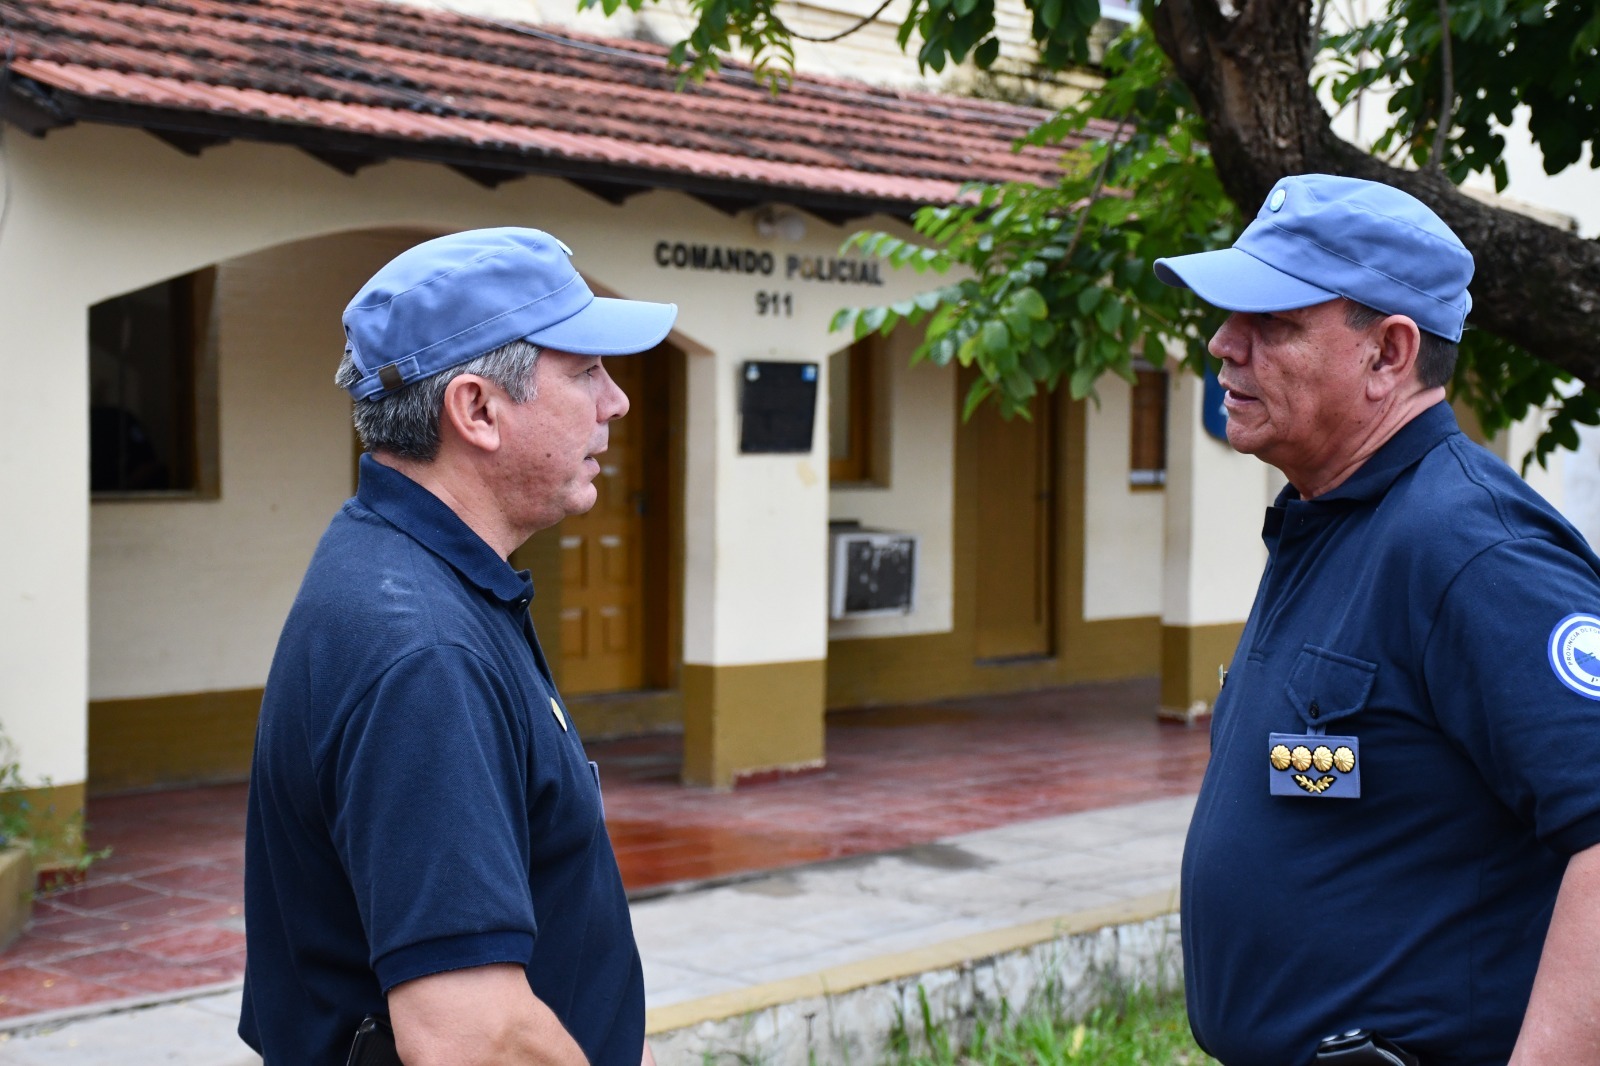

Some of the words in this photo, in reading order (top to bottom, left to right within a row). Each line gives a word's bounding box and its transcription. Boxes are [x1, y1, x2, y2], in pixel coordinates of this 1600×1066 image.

[655, 241, 774, 276] COMANDO
[786, 254, 884, 286] POLICIAL
[755, 290, 793, 316] 911
[1565, 631, 1580, 666] PROVINCIA
